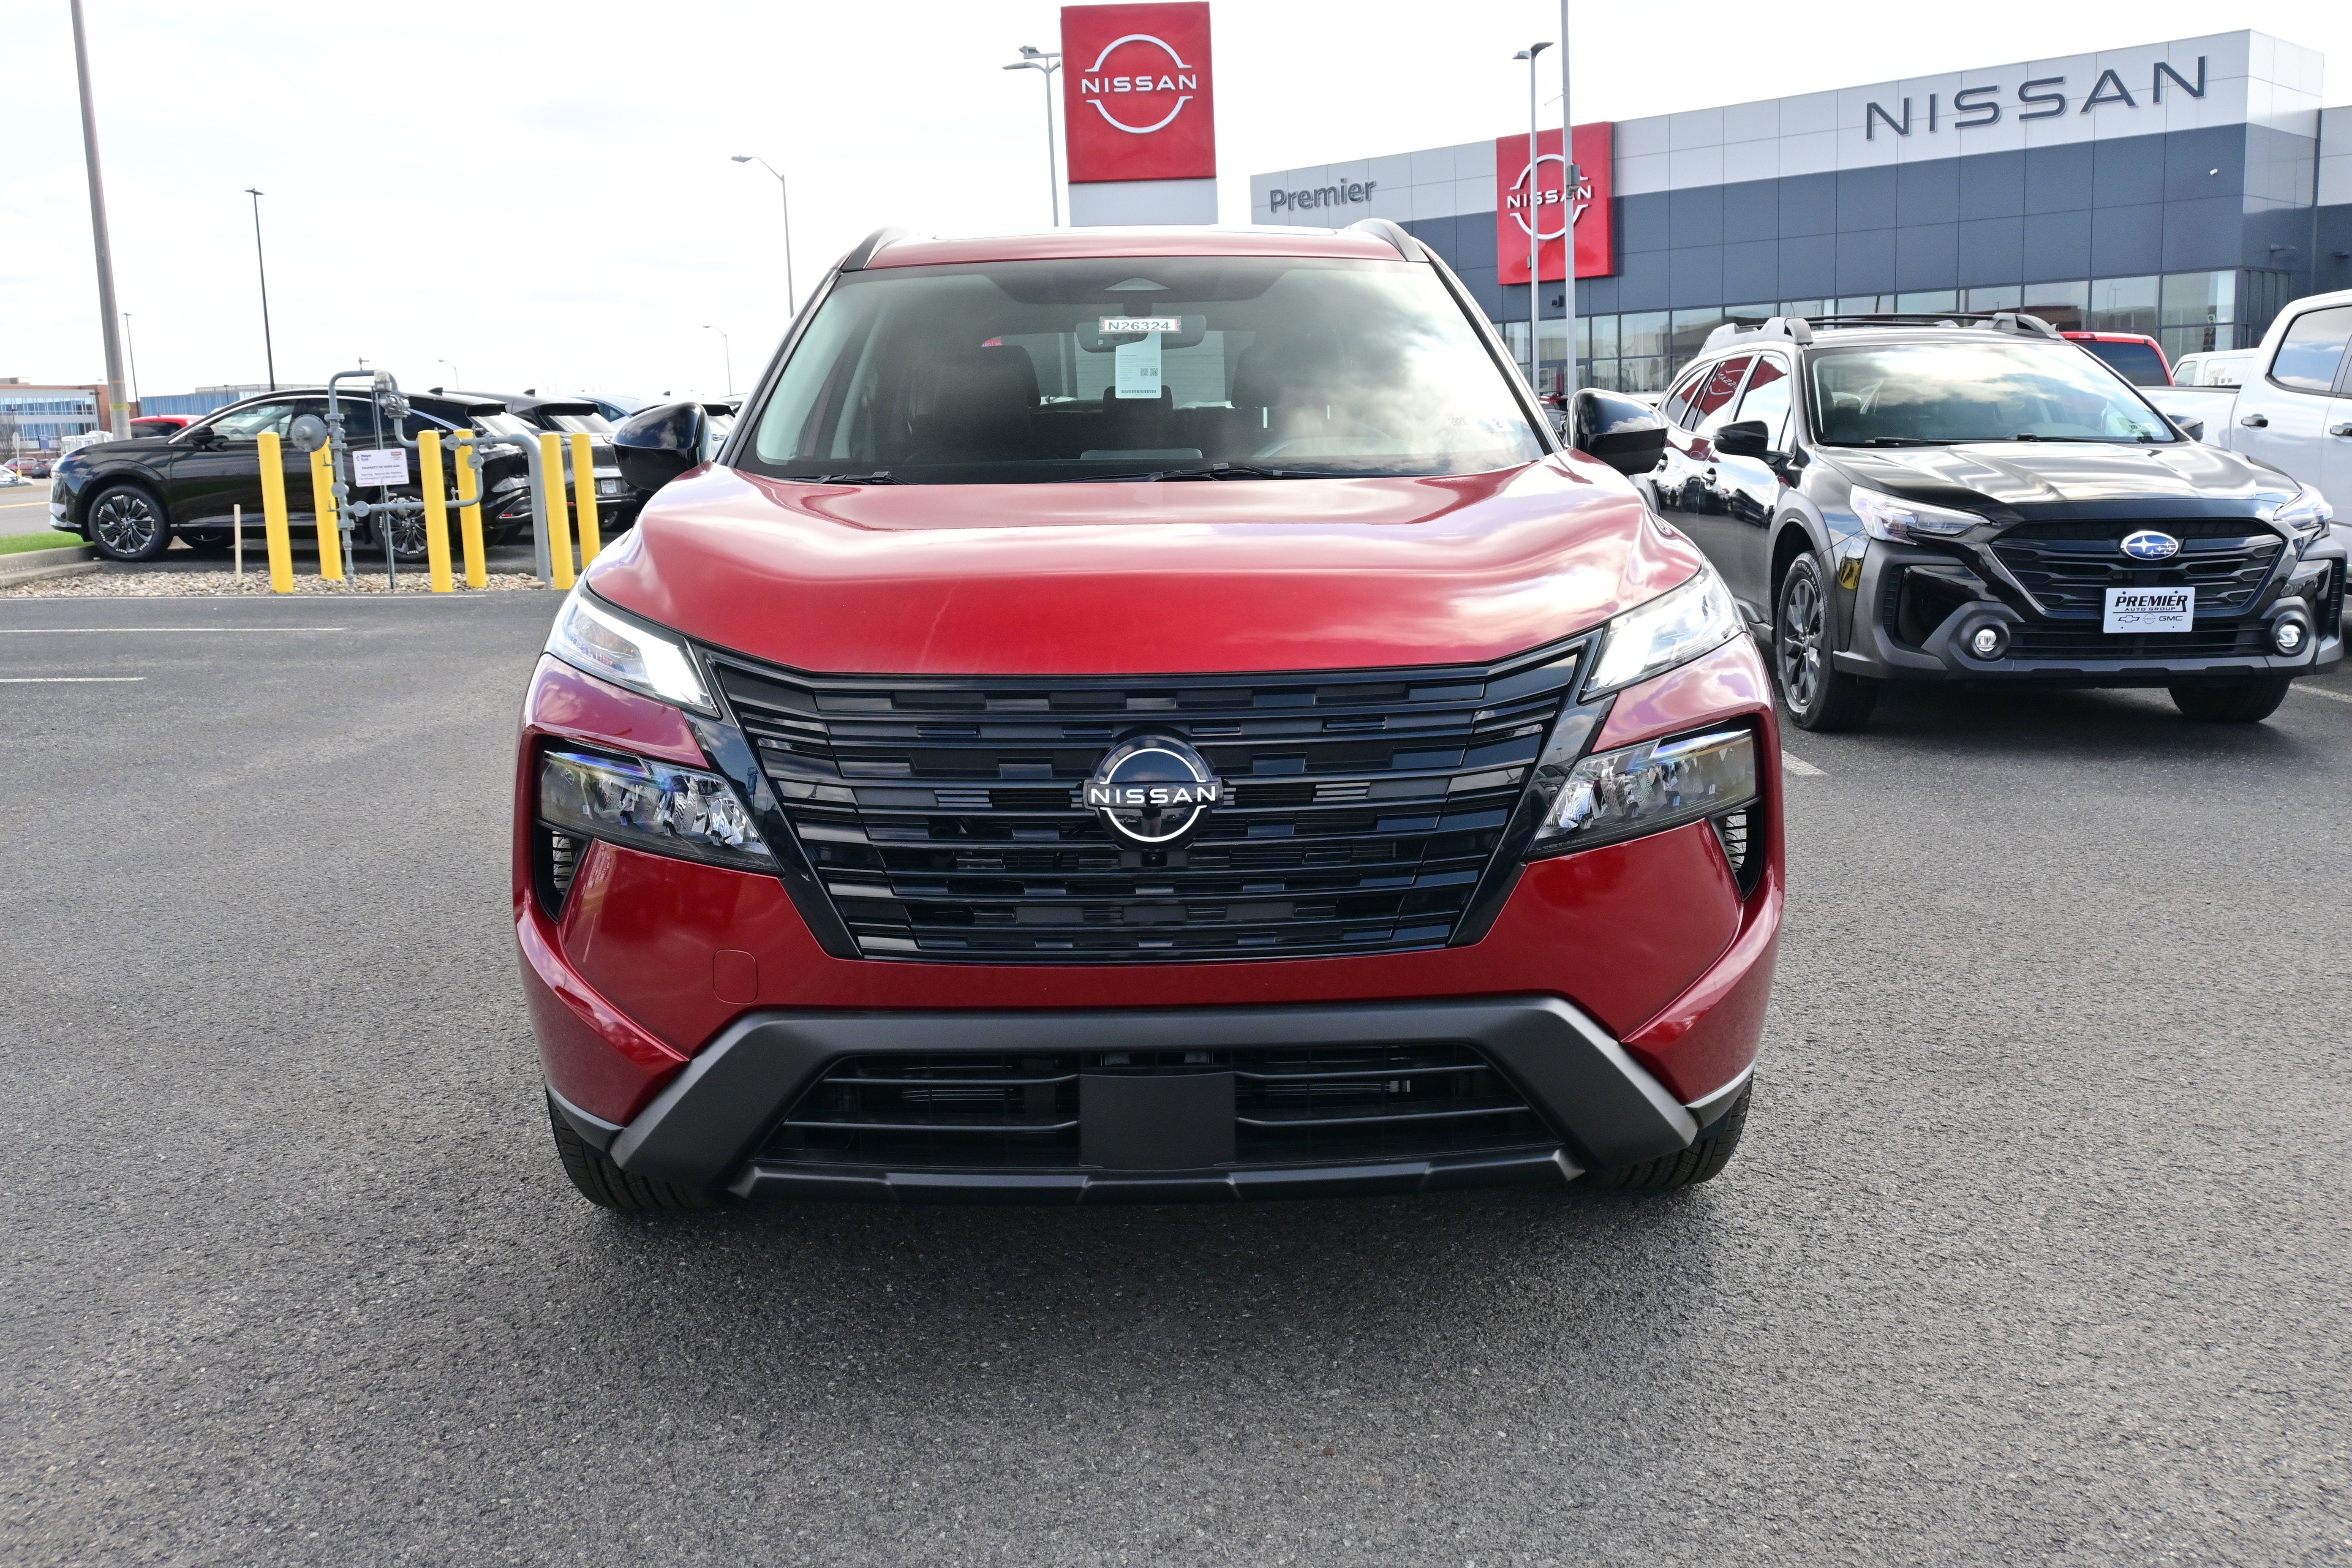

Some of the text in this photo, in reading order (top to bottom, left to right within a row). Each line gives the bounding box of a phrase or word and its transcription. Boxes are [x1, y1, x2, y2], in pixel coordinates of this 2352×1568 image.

[1082, 74, 1196, 94] NISSAN
[1866, 55, 2207, 141] NISSAN
[1270, 177, 1376, 212] Premier
[1507, 185, 1591, 209] NISSN
[1108, 321, 1170, 330] N26324
[2115, 595, 2188, 612] PREMIER
[1091, 786, 1216, 804] NISSAN
